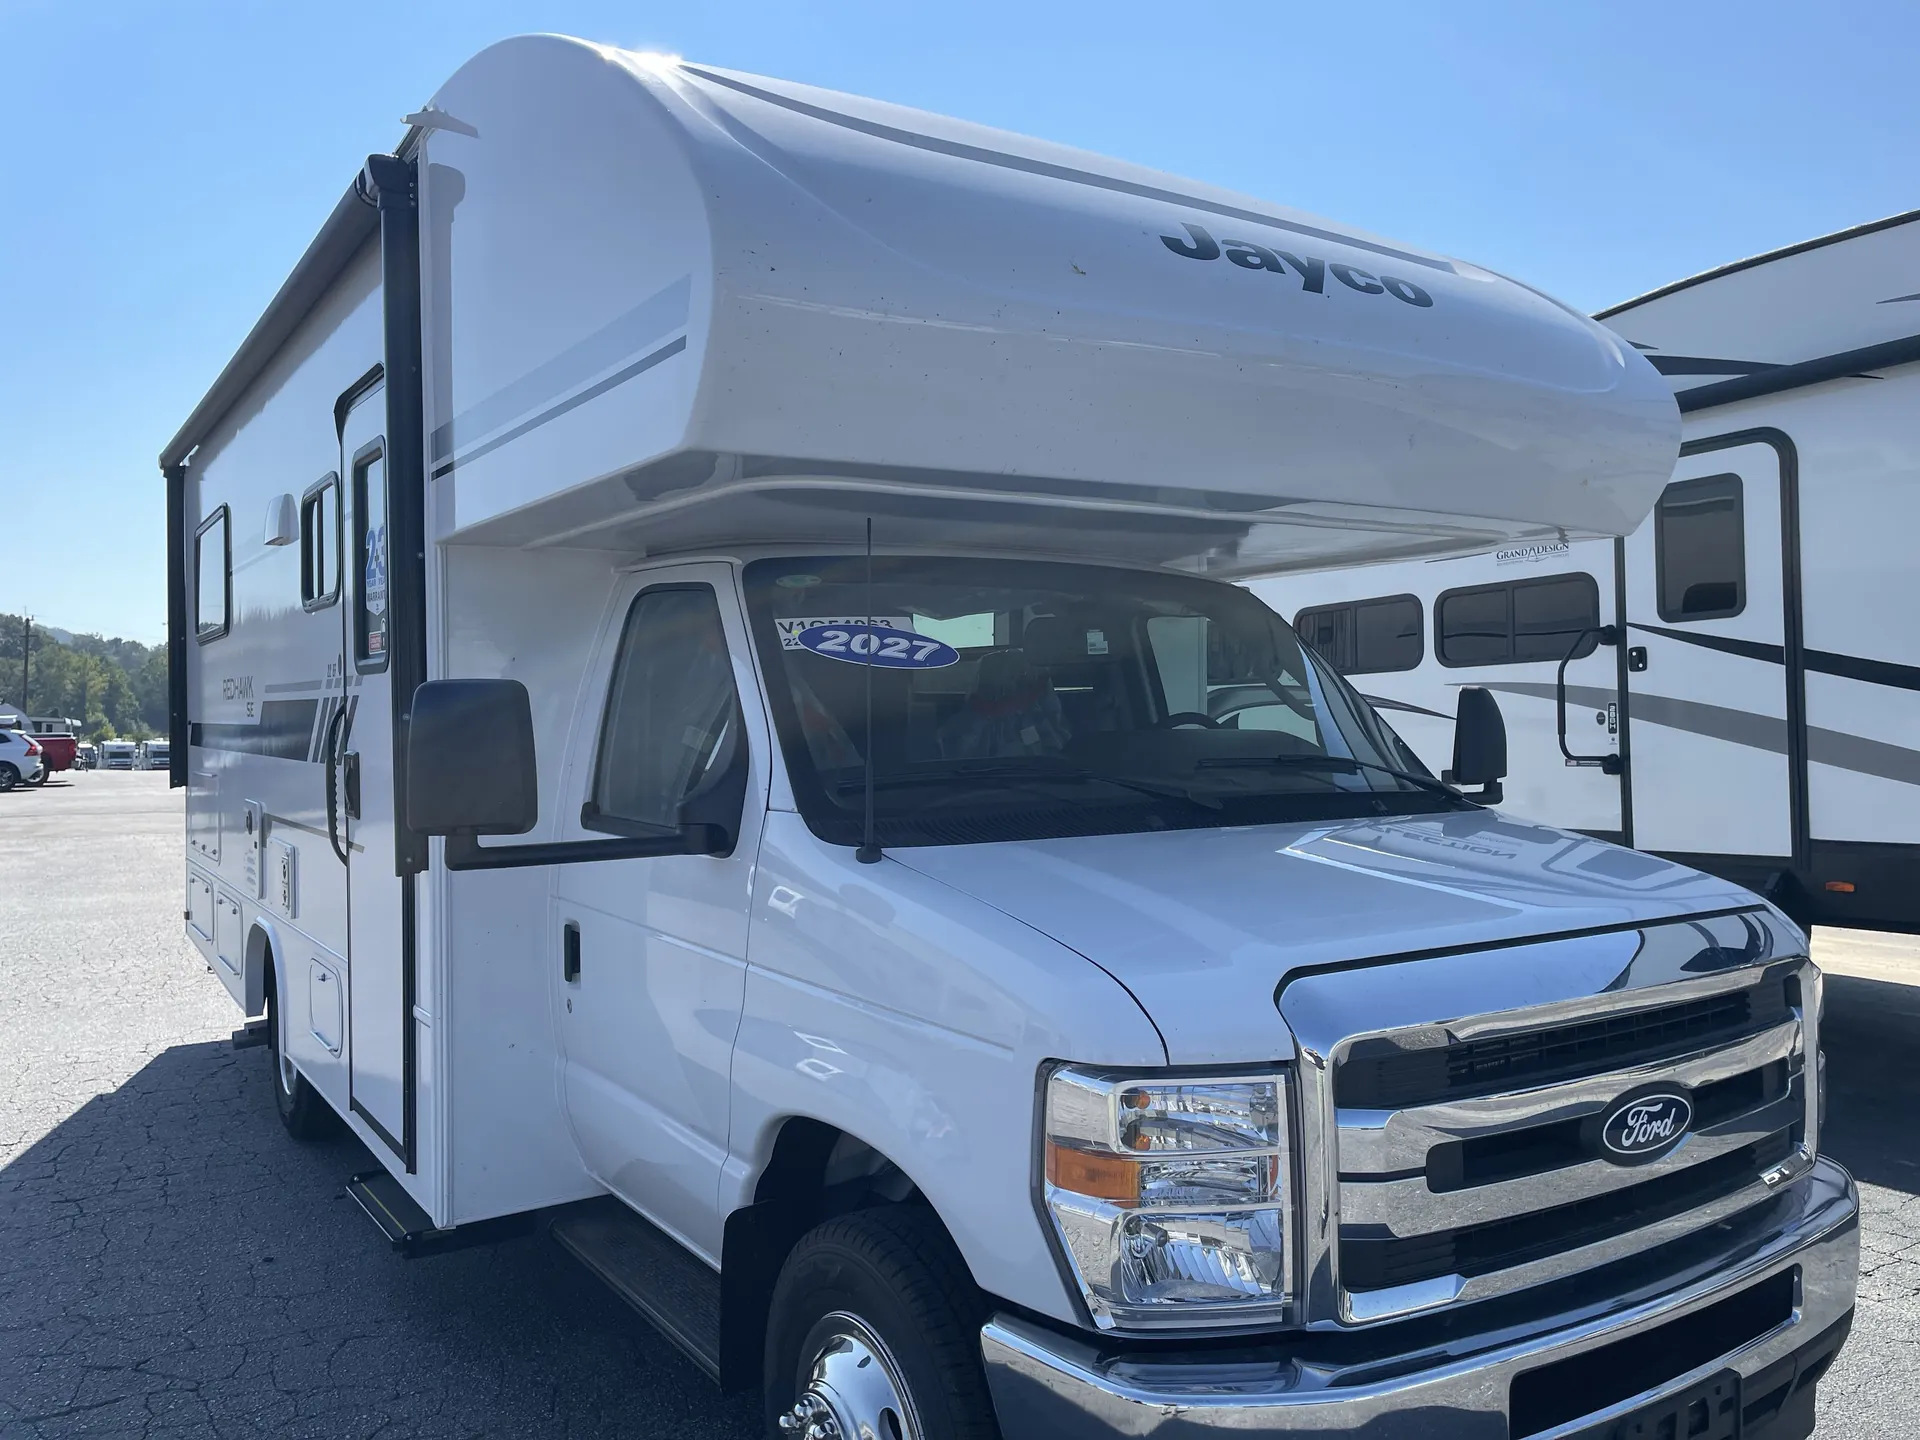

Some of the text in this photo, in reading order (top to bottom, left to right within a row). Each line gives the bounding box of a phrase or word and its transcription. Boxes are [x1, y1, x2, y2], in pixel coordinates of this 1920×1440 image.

[1159, 222, 1434, 308] Jayco
[816, 630, 941, 662] 2027
[223, 675, 254, 701] REDHAWK
[247, 702, 254, 717] SE
[1621, 1102, 1676, 1147] Ford
